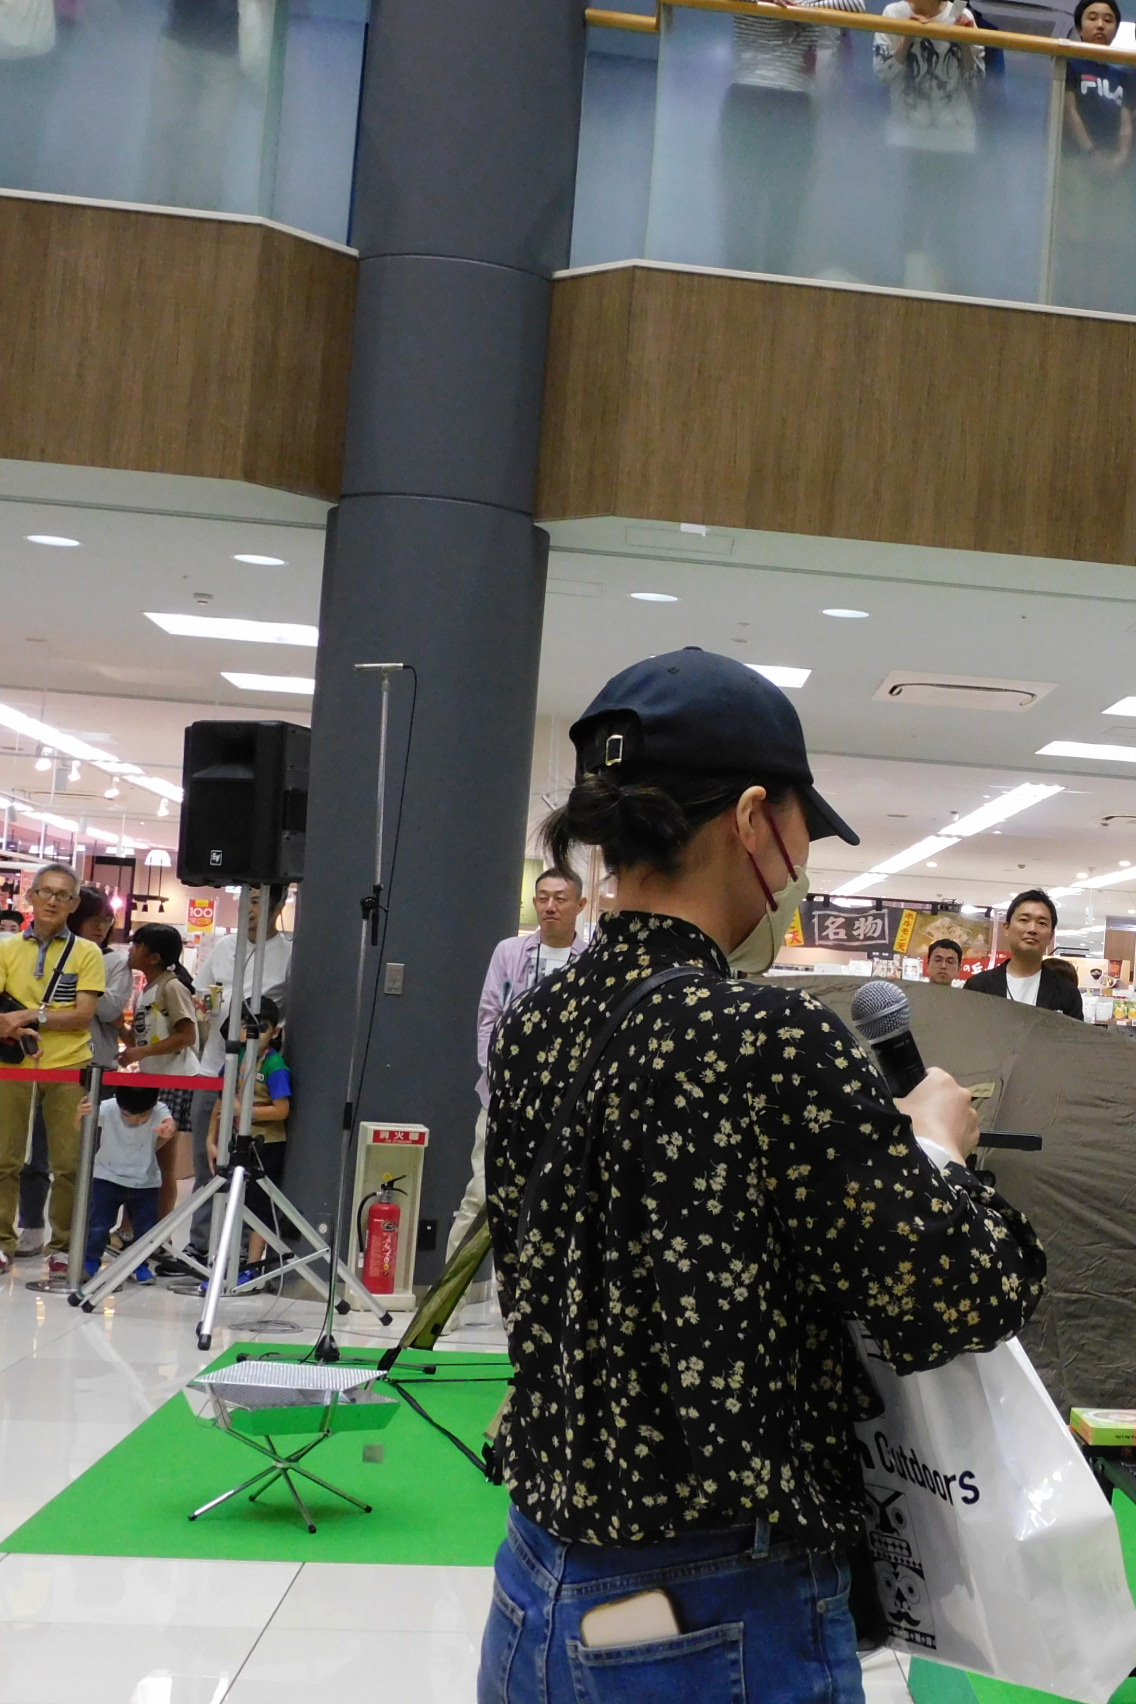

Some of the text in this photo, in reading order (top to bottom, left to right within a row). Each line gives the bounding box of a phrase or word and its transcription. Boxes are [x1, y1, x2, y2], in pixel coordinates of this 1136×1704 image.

[1080, 74, 1124, 106] FILA
[189, 907, 213, 918] 100
[821, 915, 883, 940] 名物
[895, 911, 915, 952] ホルモン天
